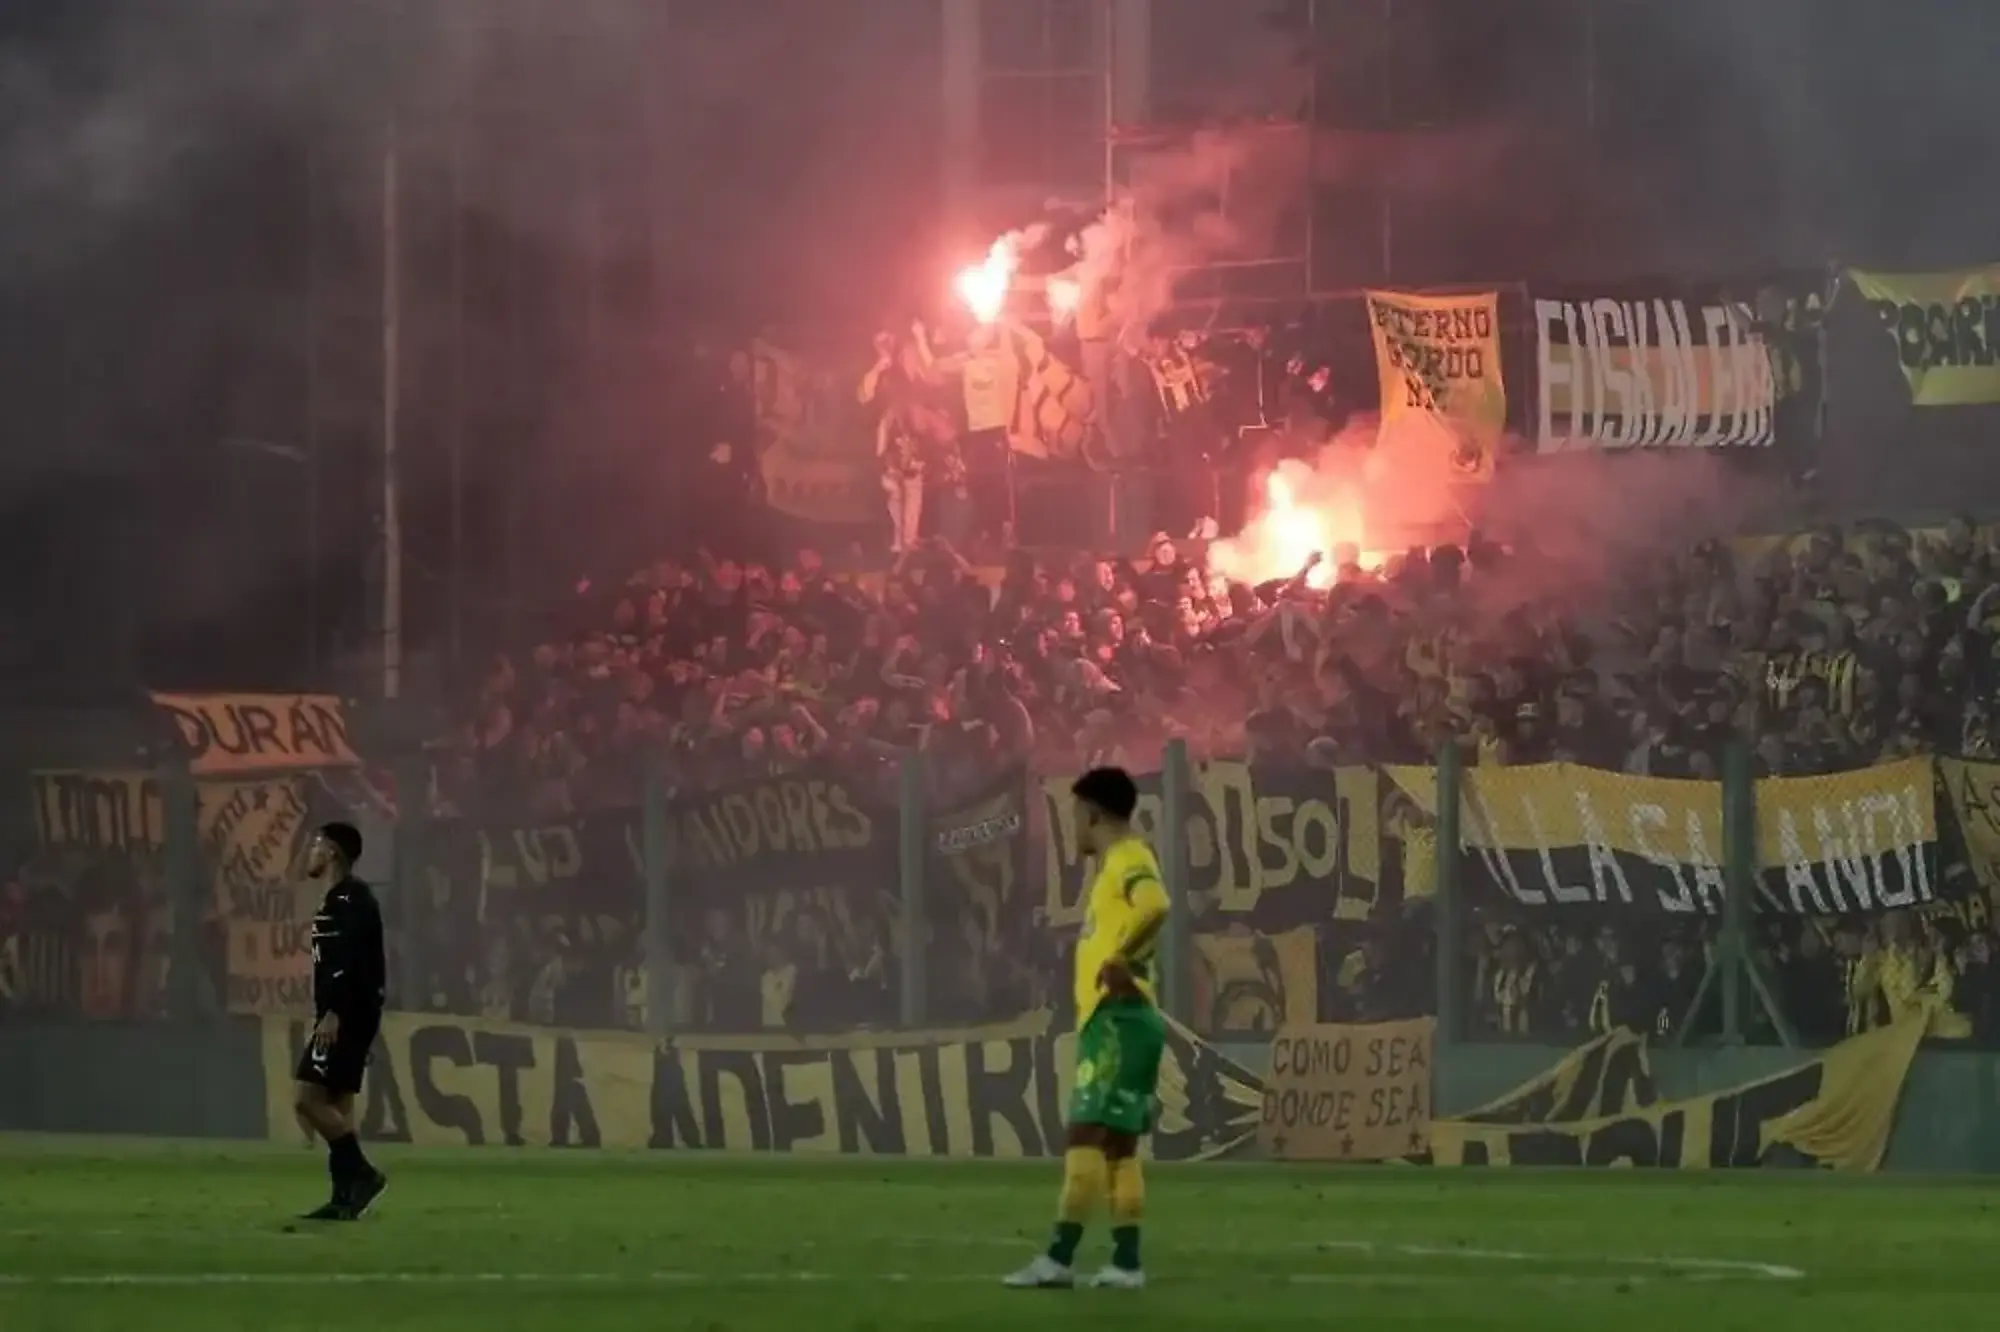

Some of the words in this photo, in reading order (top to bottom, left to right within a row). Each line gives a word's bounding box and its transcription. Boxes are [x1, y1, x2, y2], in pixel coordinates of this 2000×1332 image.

[1273, 1036, 1352, 1077] COMO
[1364, 1035, 1427, 1077] SEA
[1262, 1085, 1357, 1132] DONDE
[1363, 1079, 1424, 1129] SEA
